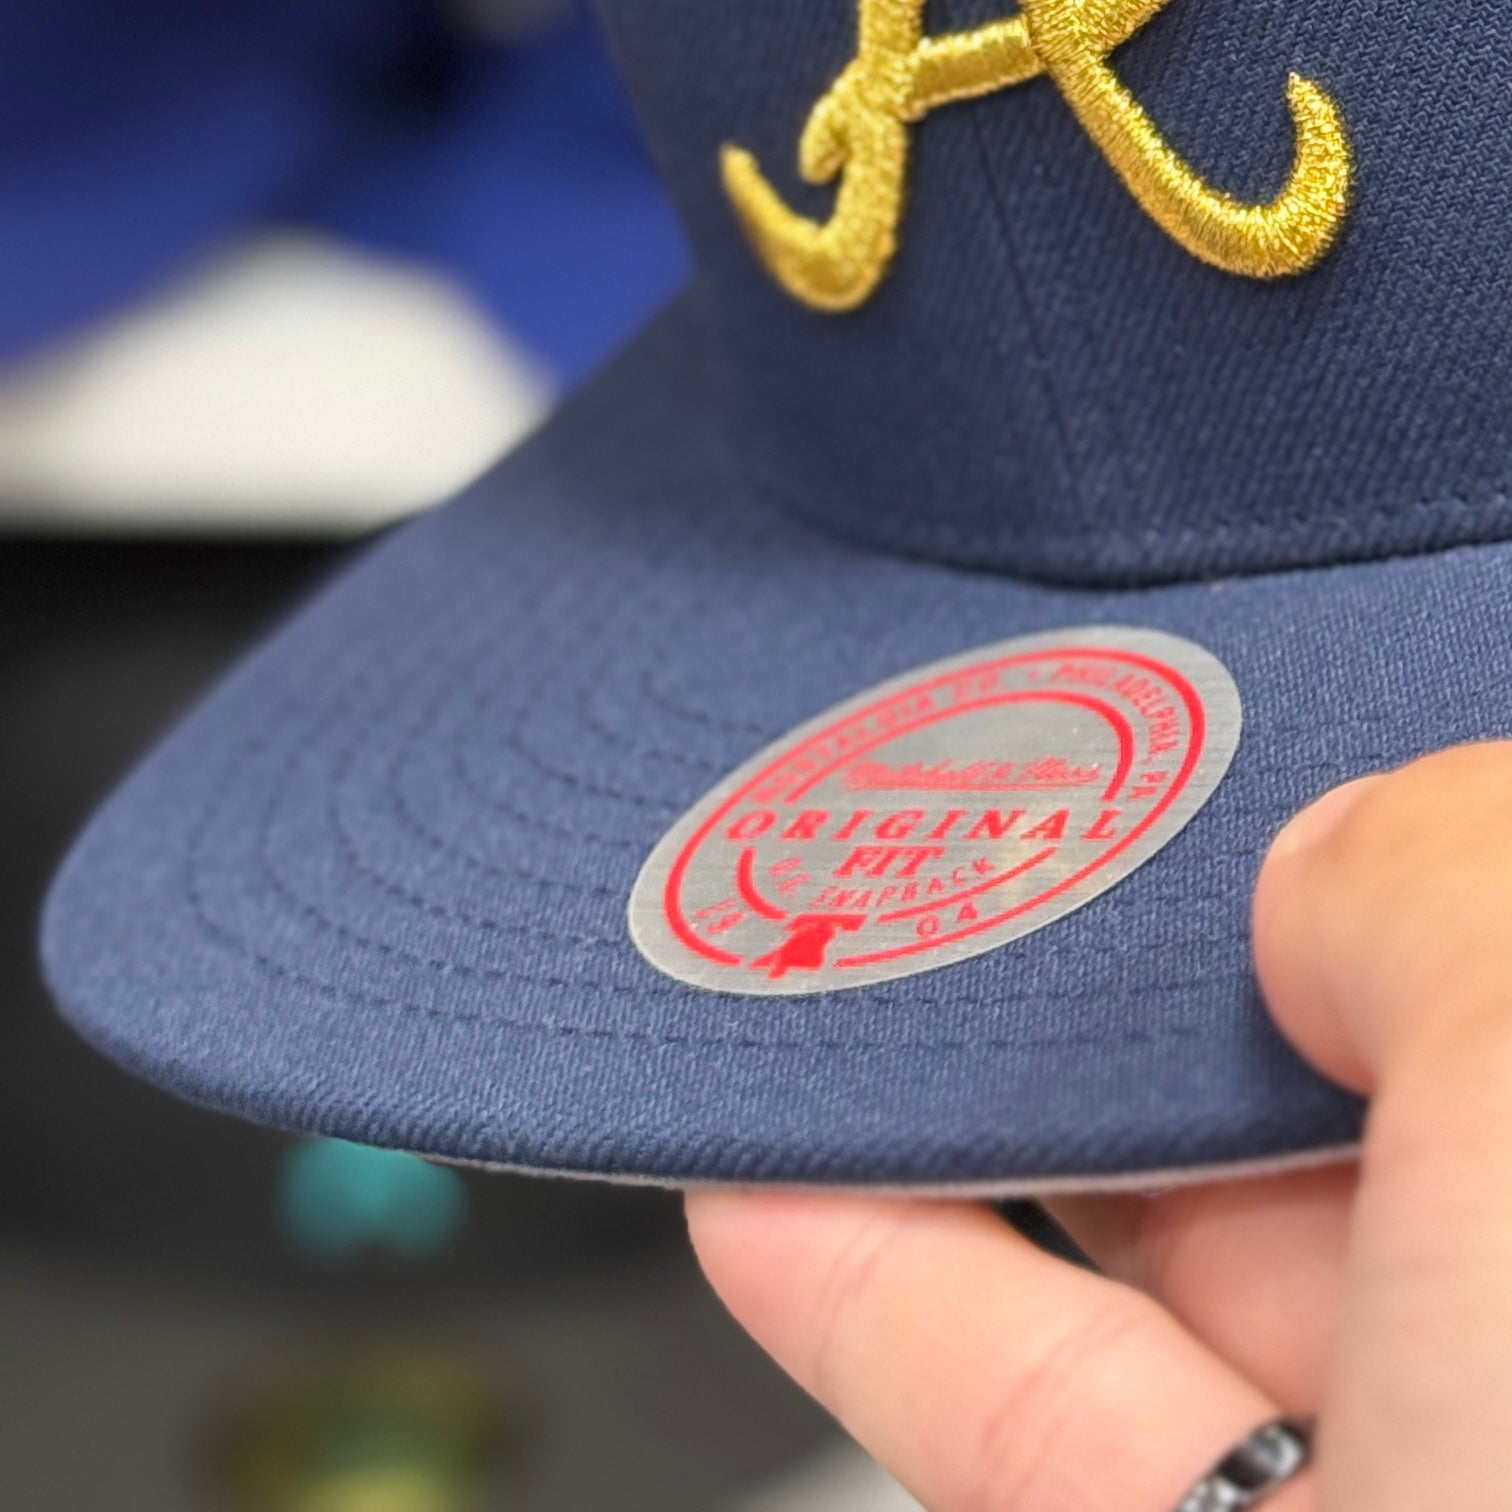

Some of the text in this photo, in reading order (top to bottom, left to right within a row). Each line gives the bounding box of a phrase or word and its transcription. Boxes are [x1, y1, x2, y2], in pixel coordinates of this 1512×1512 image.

[724, 807, 1124, 843] ORIGINAL
[831, 844, 949, 878] FIT
[808, 856, 998, 910] SNAPBACK
